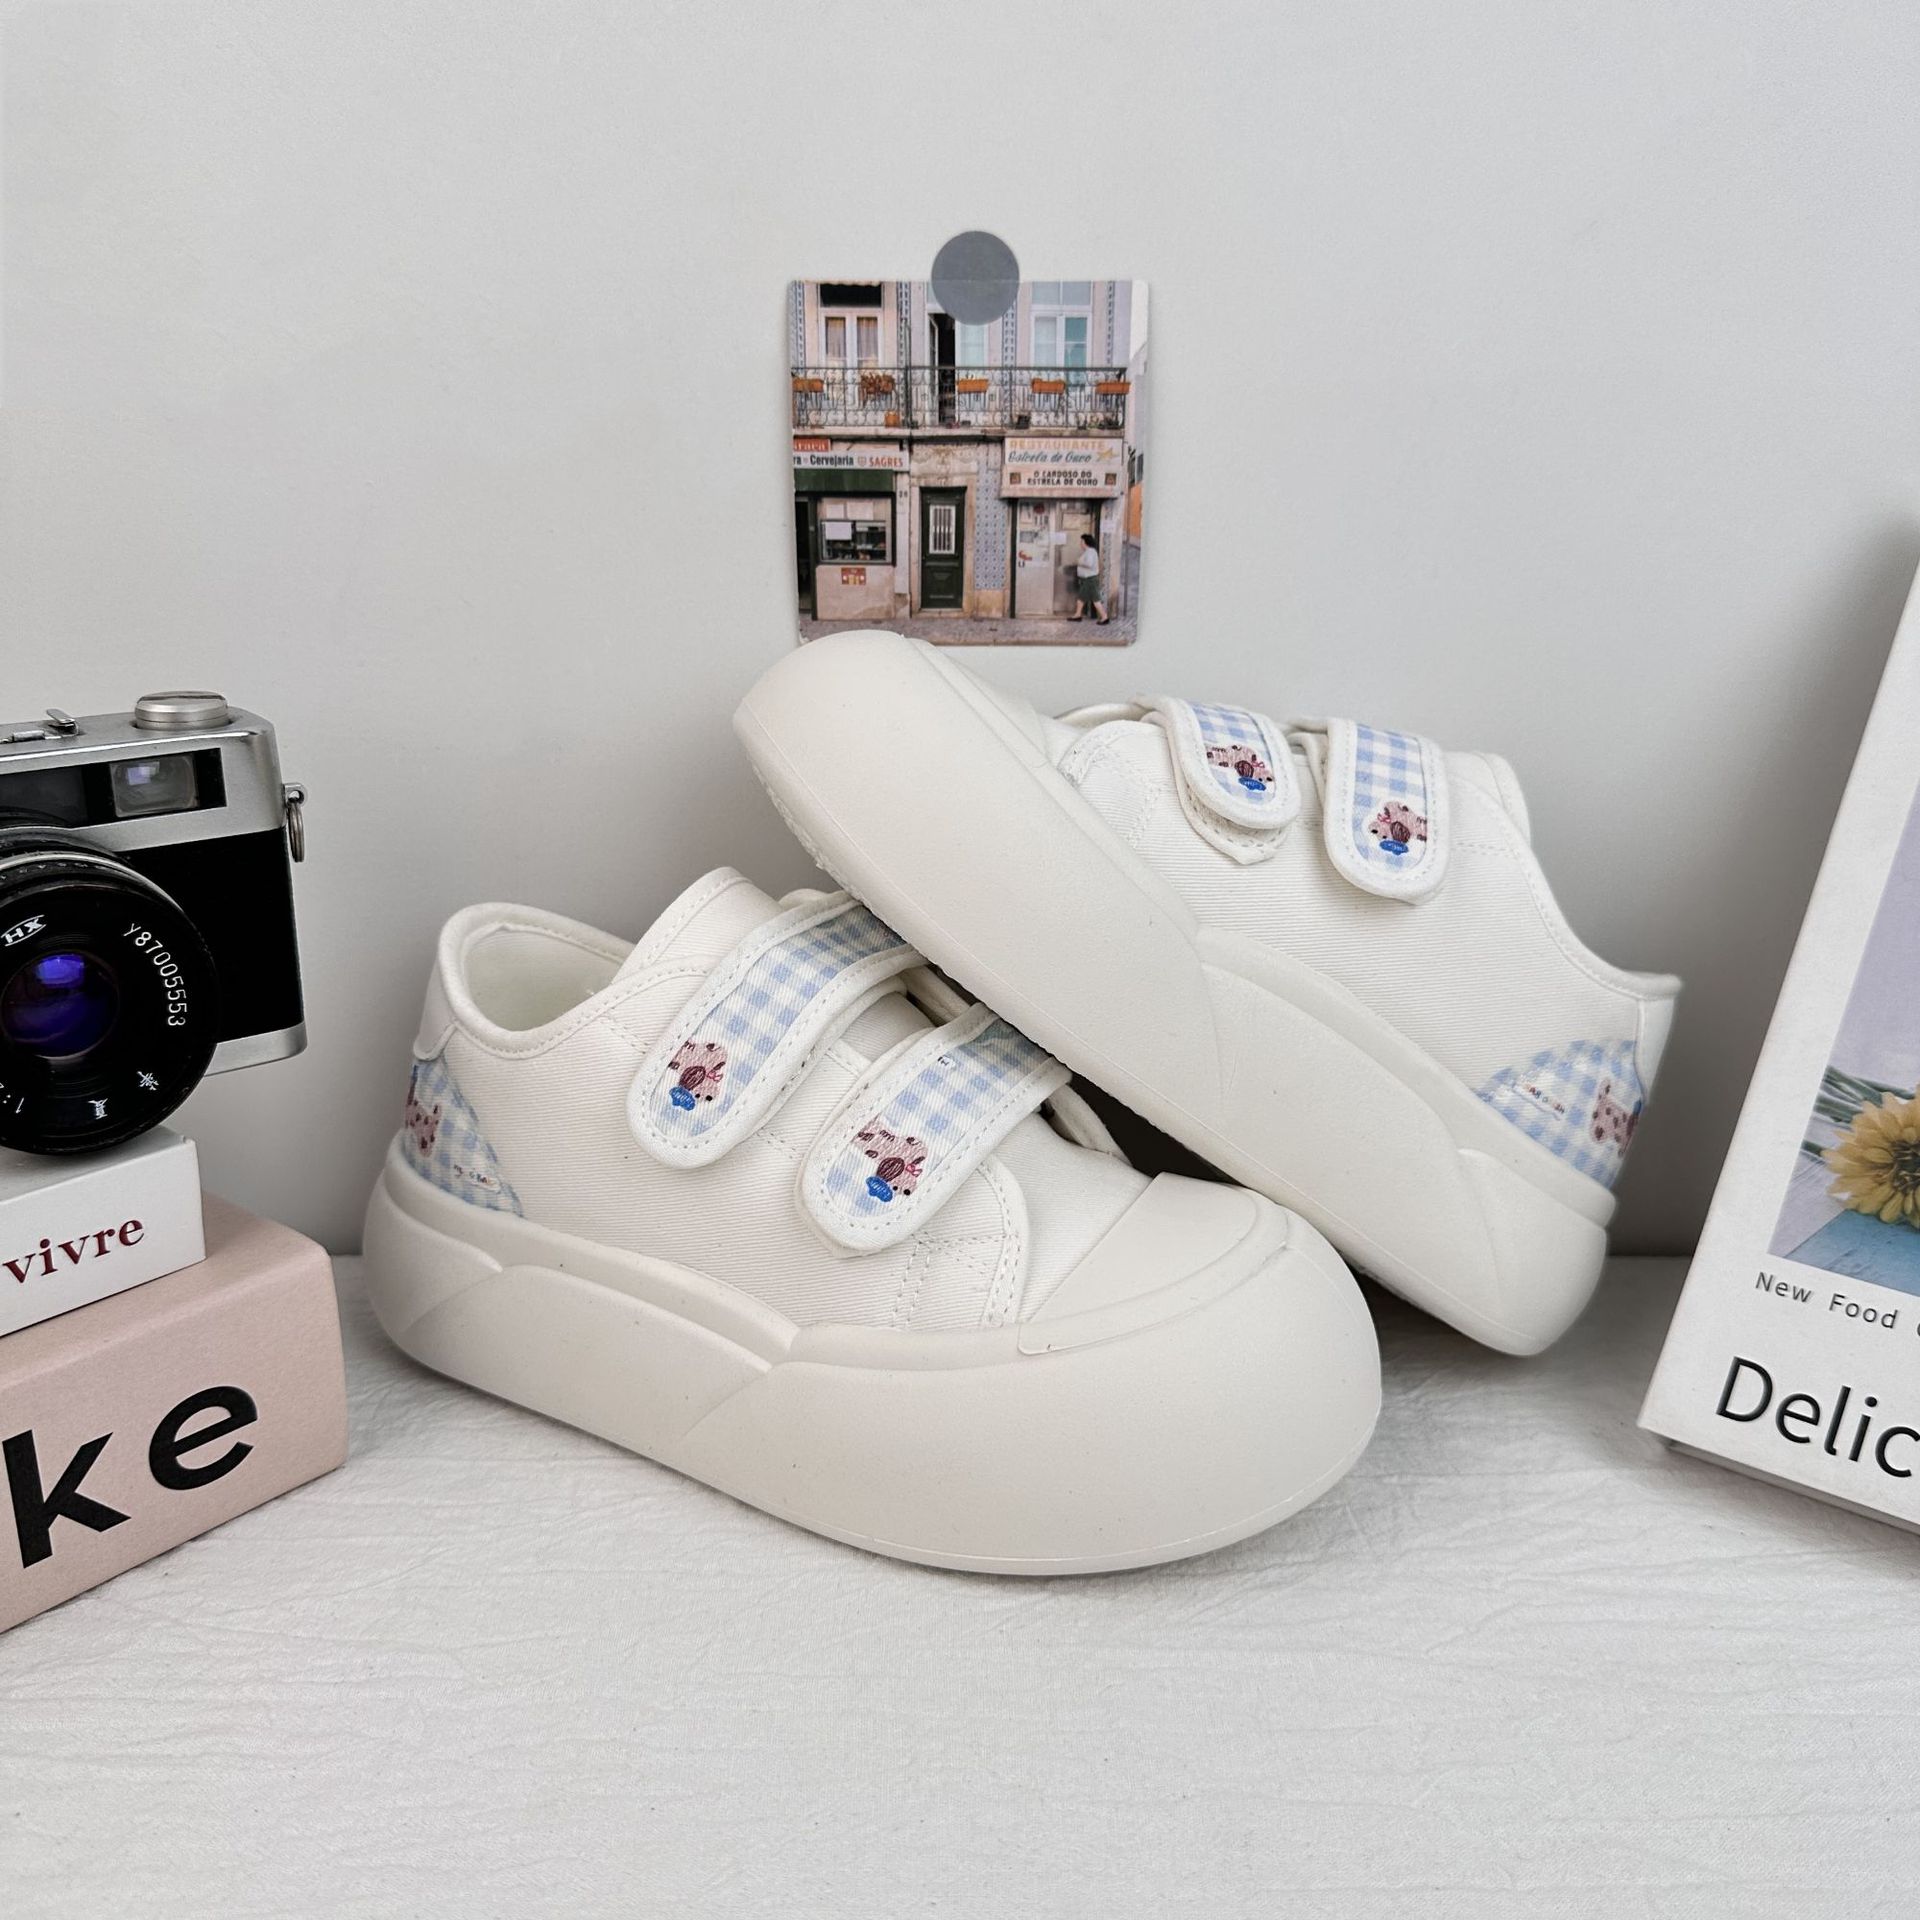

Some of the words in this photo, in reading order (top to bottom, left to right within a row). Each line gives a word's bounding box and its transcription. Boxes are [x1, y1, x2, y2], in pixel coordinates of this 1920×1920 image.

[810, 454, 854, 467] Cervejaria
[869, 457, 903, 467] SAGRES
[1007, 450, 1047, 463] Estrela
[1050, 452, 1062, 463] de
[1065, 451, 1092, 463] Ouro
[1009, 439, 1105, 449] RESTAURANTE
[1027, 478, 1060, 486] ESTRELA
[1042, 470, 1079, 478] CARDOSO
[123, 923, 187, 1027] Y87005553
[3, 1218, 145, 1285] vivre
[1755, 1271, 1813, 1304] New
[1828, 1293, 1899, 1329] Food
[1715, 1356, 1920, 1479] Delic
[2, 1385, 258, 1568] ke
